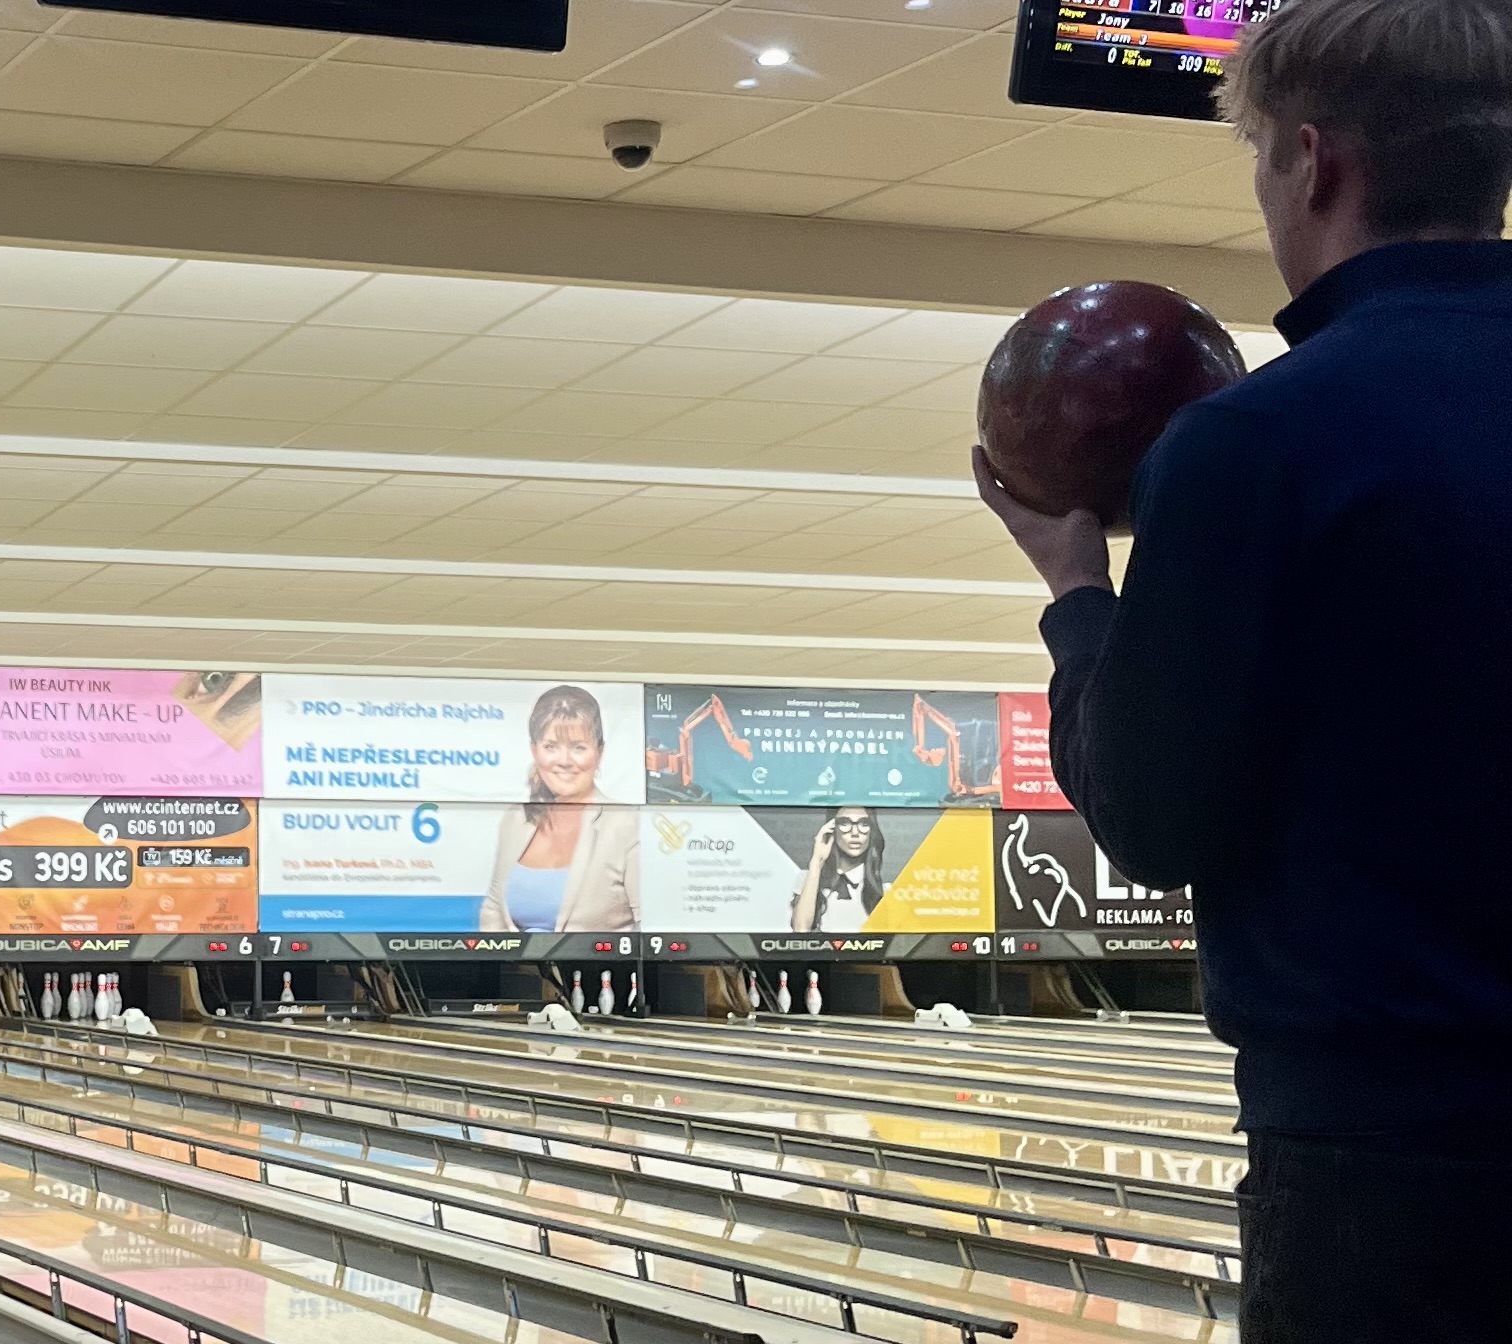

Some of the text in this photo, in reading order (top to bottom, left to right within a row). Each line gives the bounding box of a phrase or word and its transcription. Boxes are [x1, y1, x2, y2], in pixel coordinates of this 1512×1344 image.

[1097, 12, 1131, 28] Jony
[1095, 29, 1203, 72] Team 309
[8, 678, 113, 693] IW BEAUTY INK
[76, 703, 138, 722] MAKE
[156, 703, 184, 724] UP
[302, 700, 505, 723] PRO Jindřicha Rajchla
[743, 727, 904, 741] PRODEJ A PRONÁJEM
[285, 741, 501, 766] MĚ NEPŘESLECHNOU
[761, 739, 889, 755] MINIRÝPADEL
[287, 768, 420, 789] ANI NEUMLČÍ
[102, 798, 240, 816] www.ccinternet.cz
[127, 818, 216, 836] 606 101 100
[282, 802, 443, 844] BUDU VOLIT 6
[169, 848, 193, 865] 159
[194, 849, 212, 865] Kč
[34, 851, 87, 883] 399
[94, 852, 128, 883] Kč
[1096, 909, 1163, 924] REKLAMA
[238, 936, 253, 954] 6
[268, 936, 632, 955] 7 8
[650, 936, 663, 954] 9
[972, 936, 990, 954] 10
[1000, 937, 1016, 954] 11
